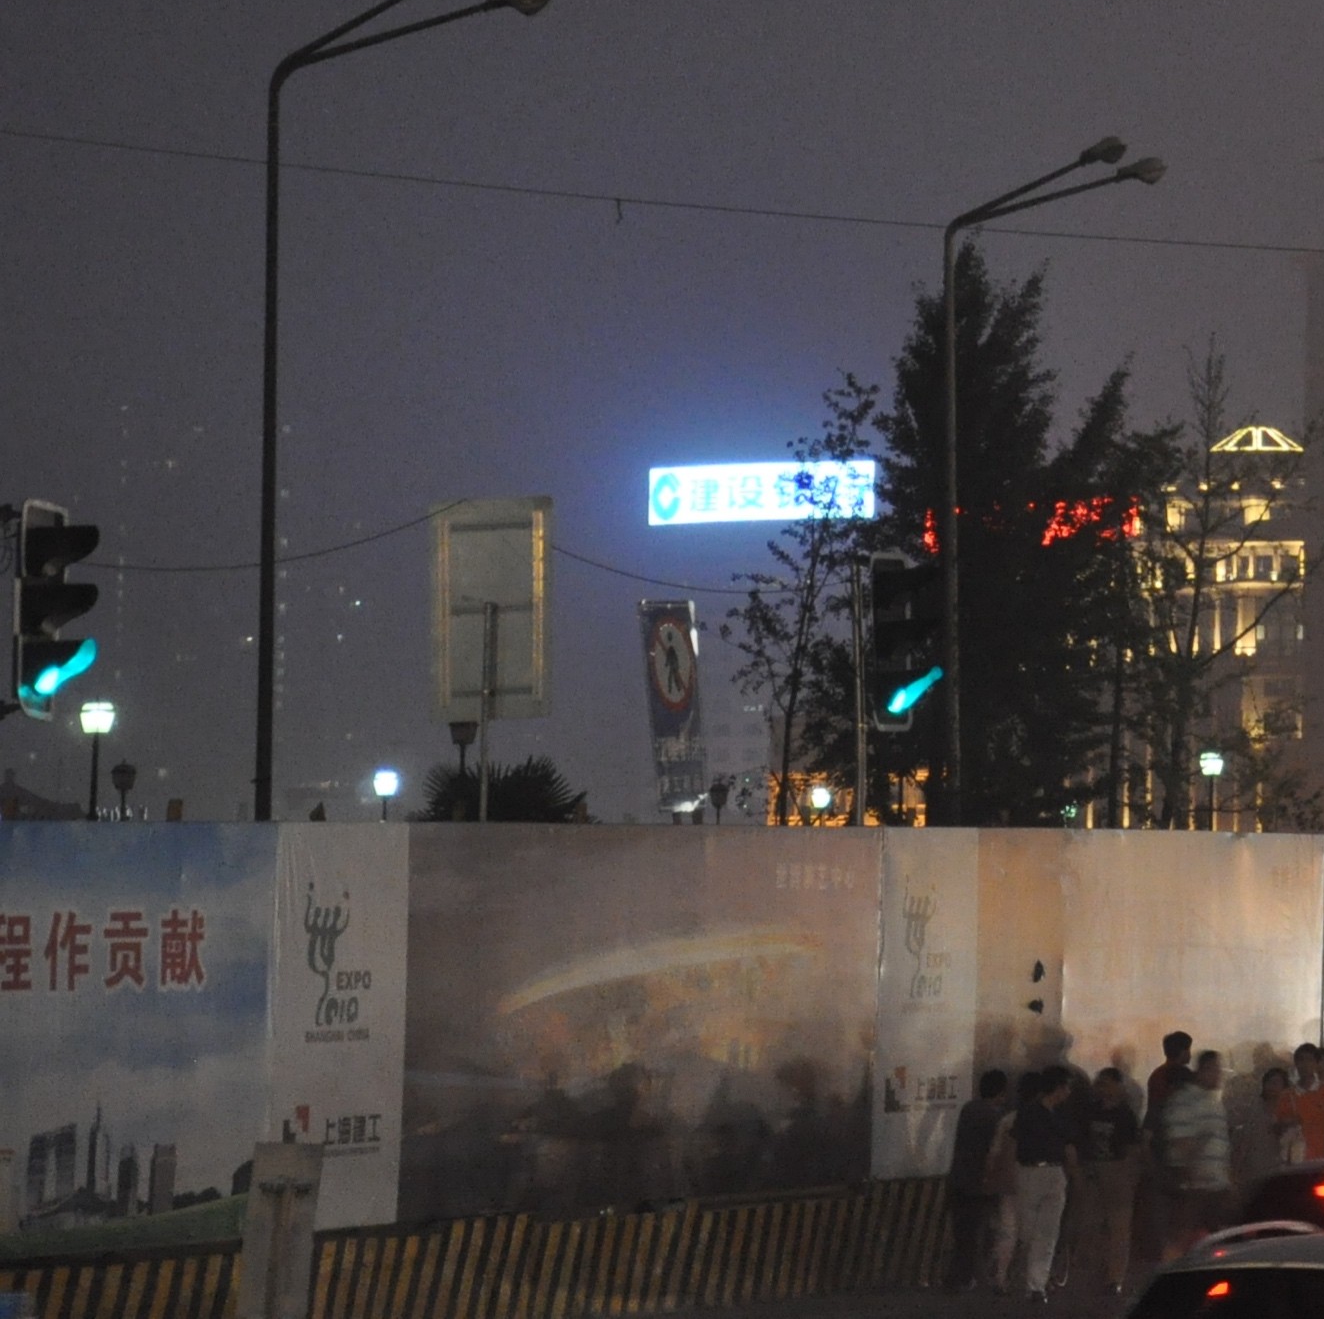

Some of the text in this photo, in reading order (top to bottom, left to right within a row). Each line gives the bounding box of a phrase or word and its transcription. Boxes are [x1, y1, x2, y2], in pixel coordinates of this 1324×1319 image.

[0, 908, 206, 991] 程作贡献
[336, 970, 372, 990] EXPO
